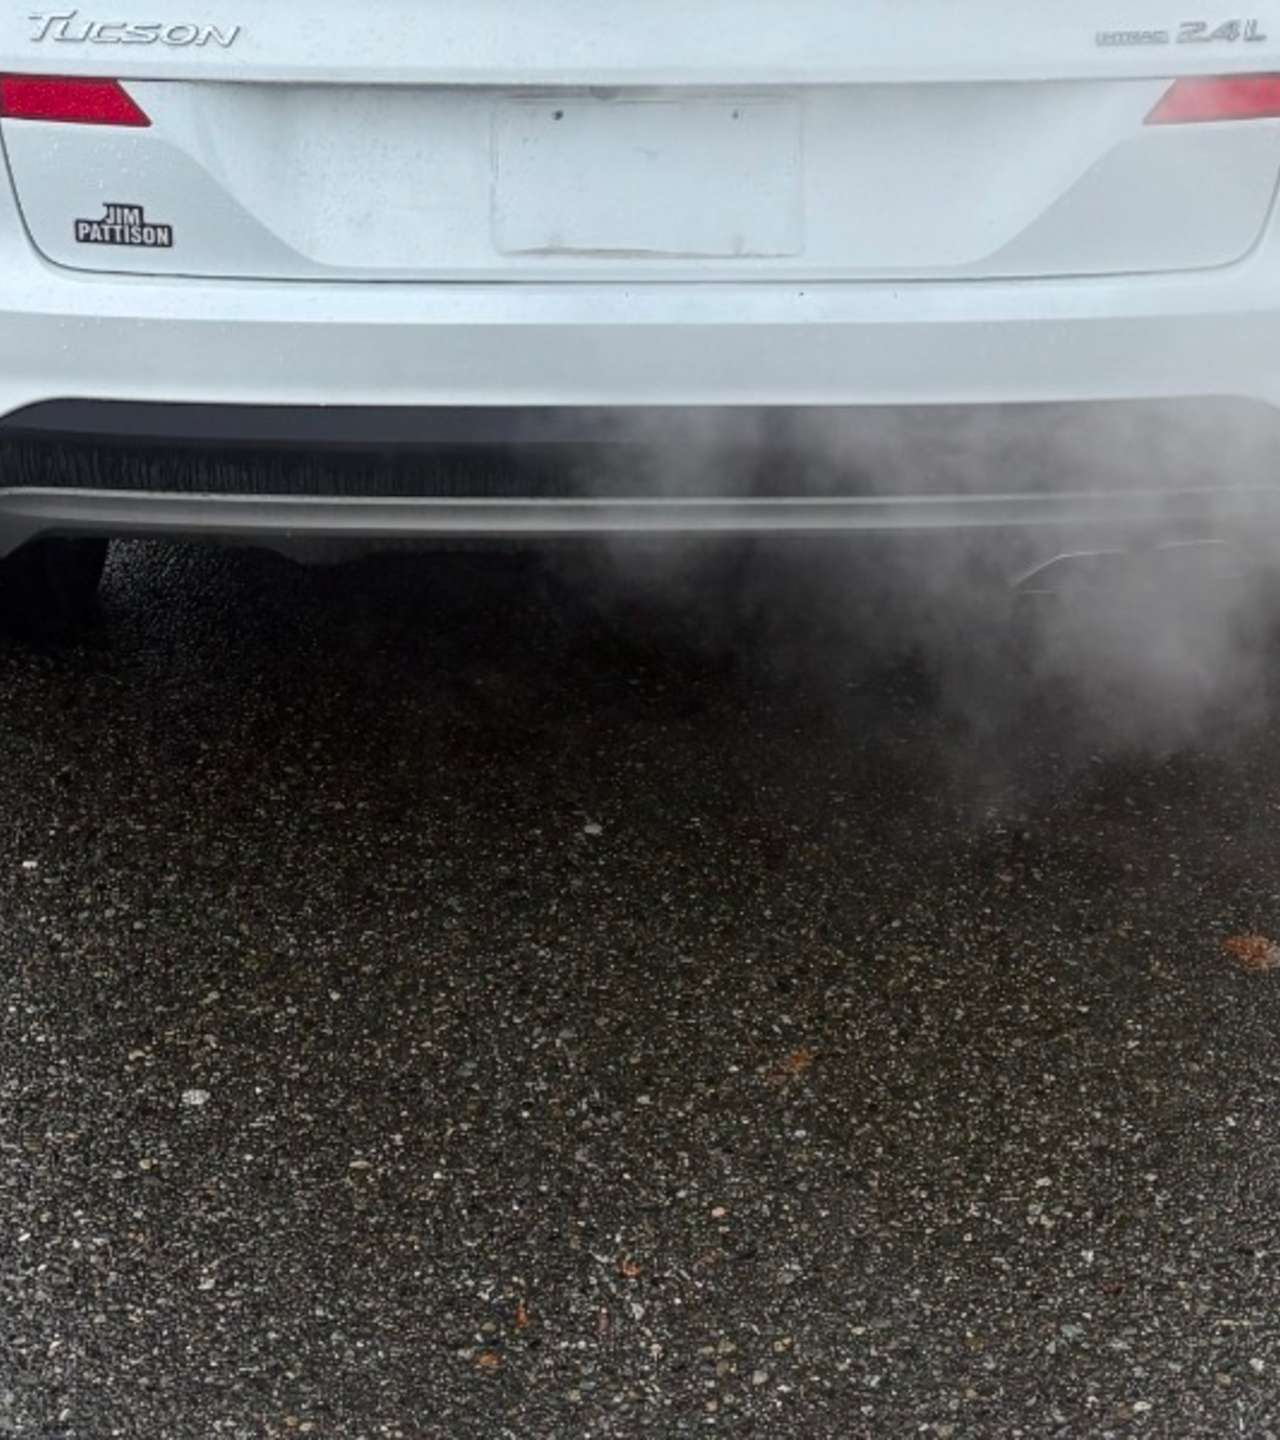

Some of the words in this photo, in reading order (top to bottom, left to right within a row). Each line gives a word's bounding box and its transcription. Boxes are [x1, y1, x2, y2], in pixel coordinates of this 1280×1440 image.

[28, 10, 240, 48] TUCSON
[105, 205, 141, 225] JIM
[77, 222, 170, 245] PATTISON
